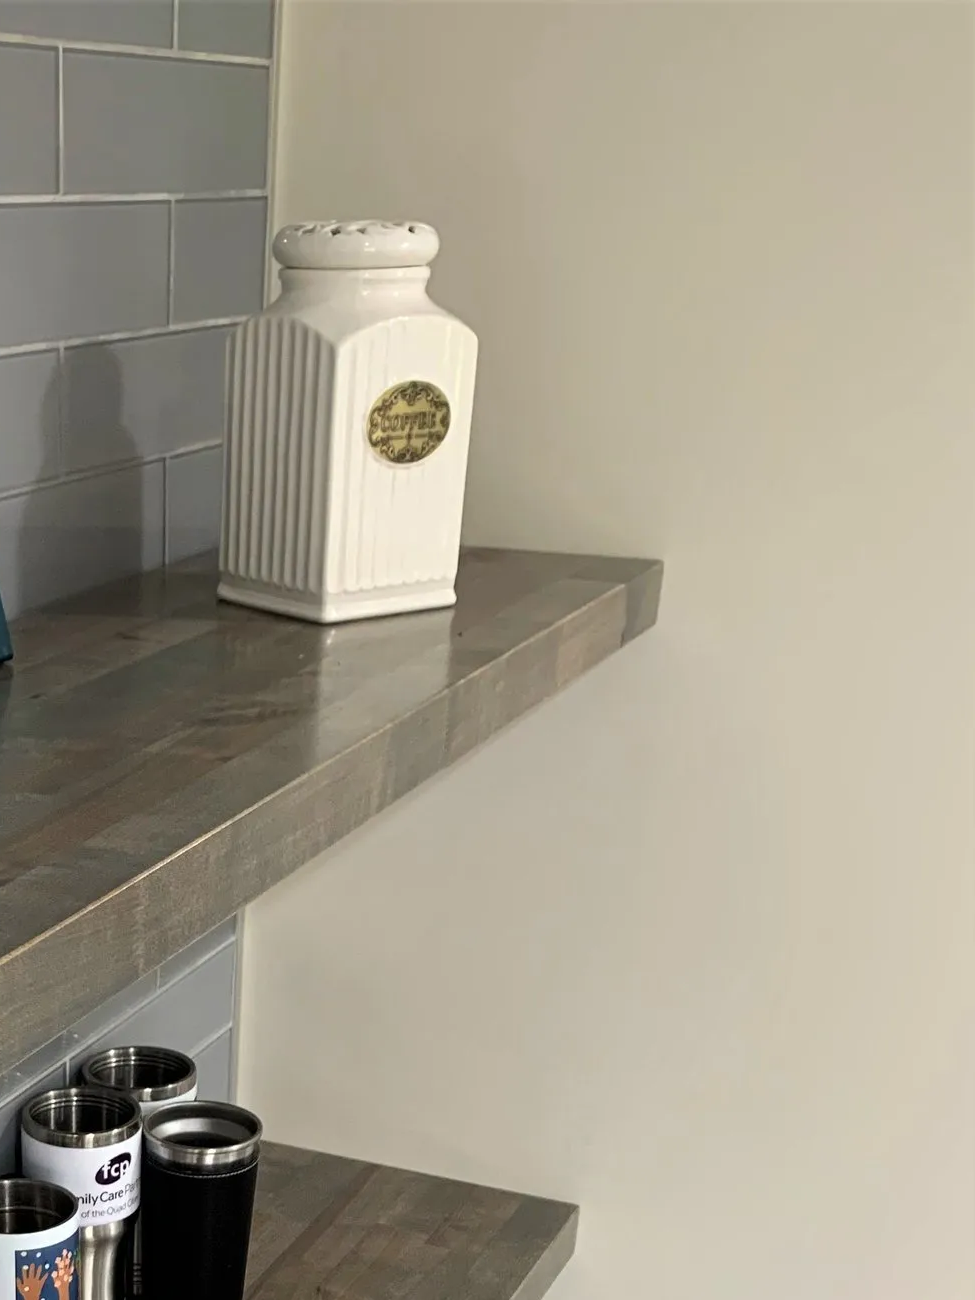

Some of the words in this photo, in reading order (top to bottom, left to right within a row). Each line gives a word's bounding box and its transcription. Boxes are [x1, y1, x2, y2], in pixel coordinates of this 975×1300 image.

[101, 1159, 130, 1180] fcp
[100, 1190, 124, 1203] Care
[80, 1209, 91, 1219] of
[91, 1209, 105, 1217] the
